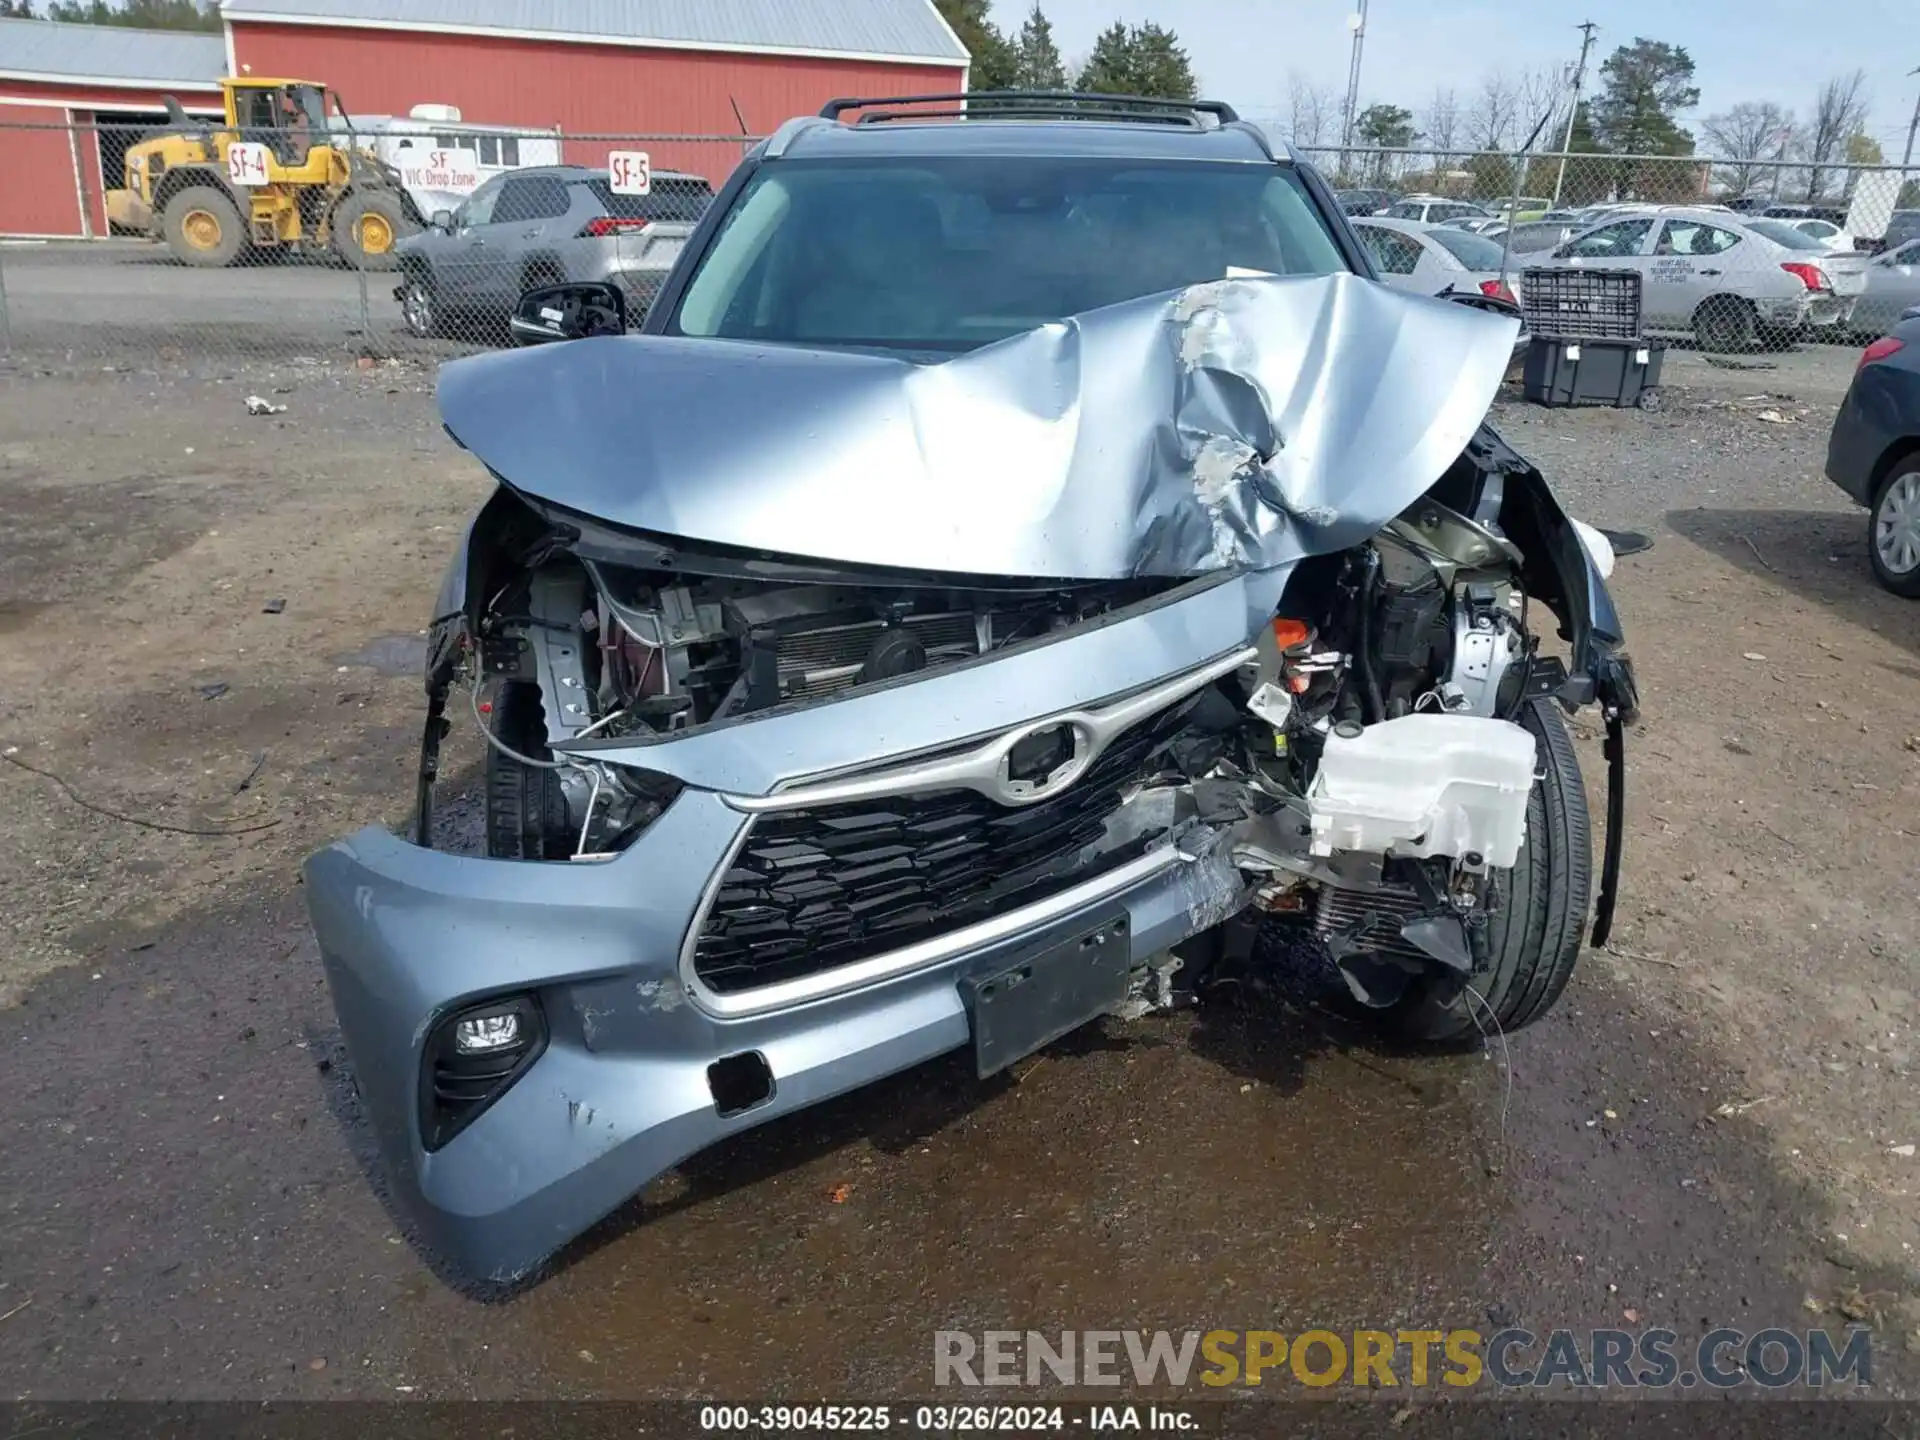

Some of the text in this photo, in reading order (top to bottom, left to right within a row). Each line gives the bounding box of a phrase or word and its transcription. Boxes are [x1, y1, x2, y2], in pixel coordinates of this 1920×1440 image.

[231, 148, 265, 178] SF-4
[430, 151, 448, 168] SF
[613, 157, 648, 187] SF-5
[425, 168, 450, 188] Drop
[451, 168, 476, 187] Zone
